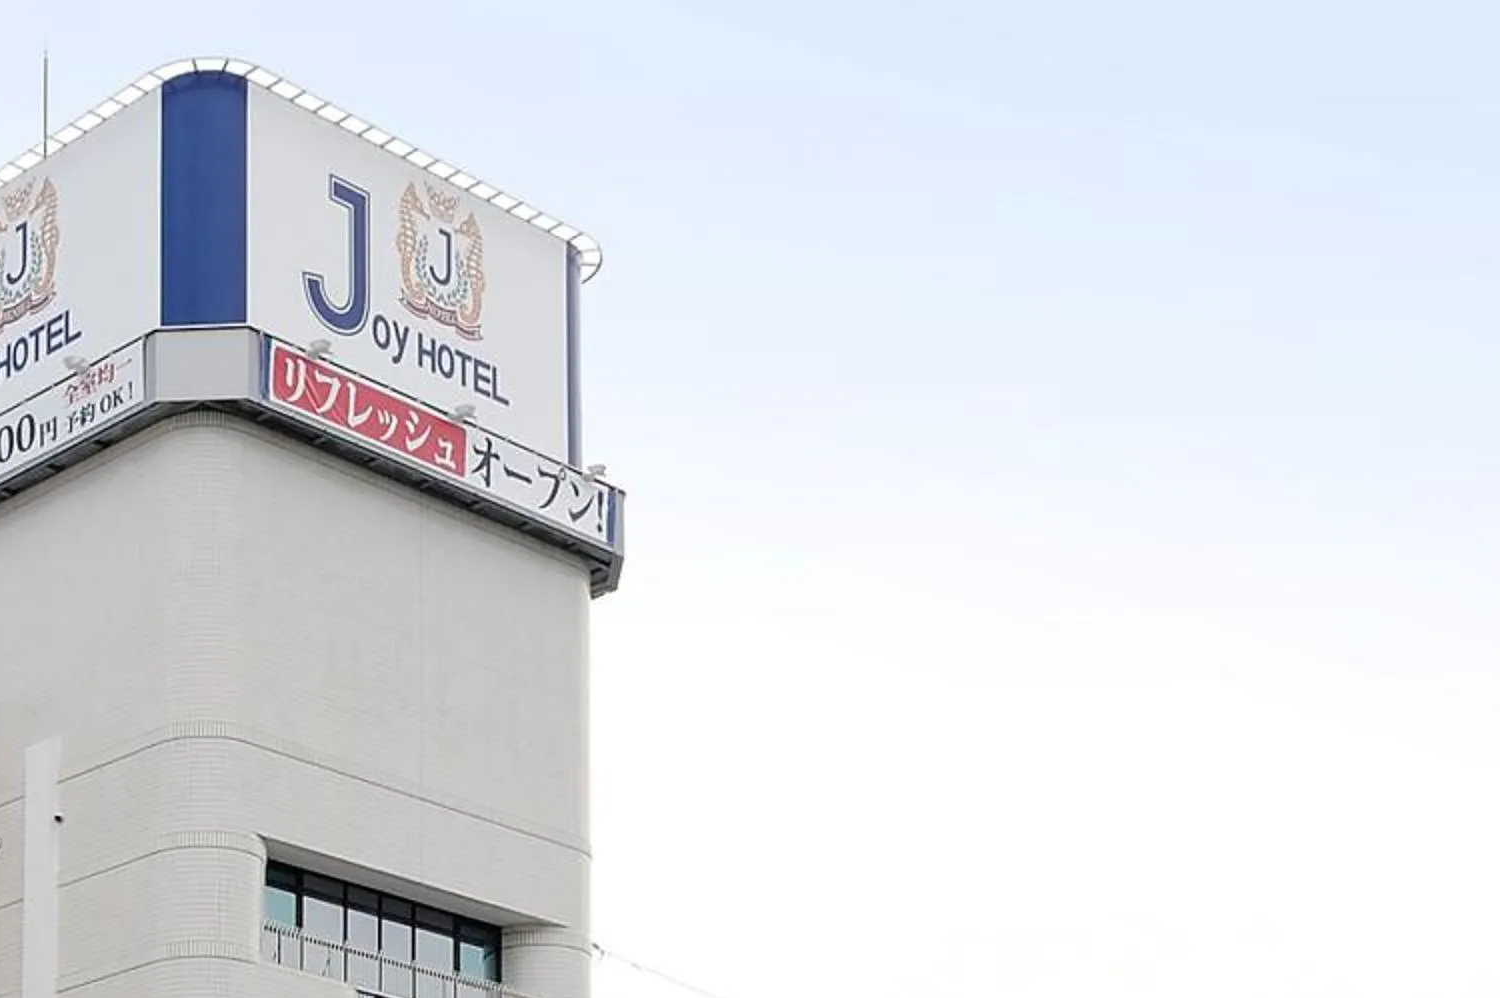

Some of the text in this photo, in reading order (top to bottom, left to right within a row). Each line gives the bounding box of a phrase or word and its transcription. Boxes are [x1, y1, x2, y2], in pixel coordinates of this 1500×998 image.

[417, 332, 510, 407] HOTEL
[284, 356, 603, 532] リフレッシュ オープン!
